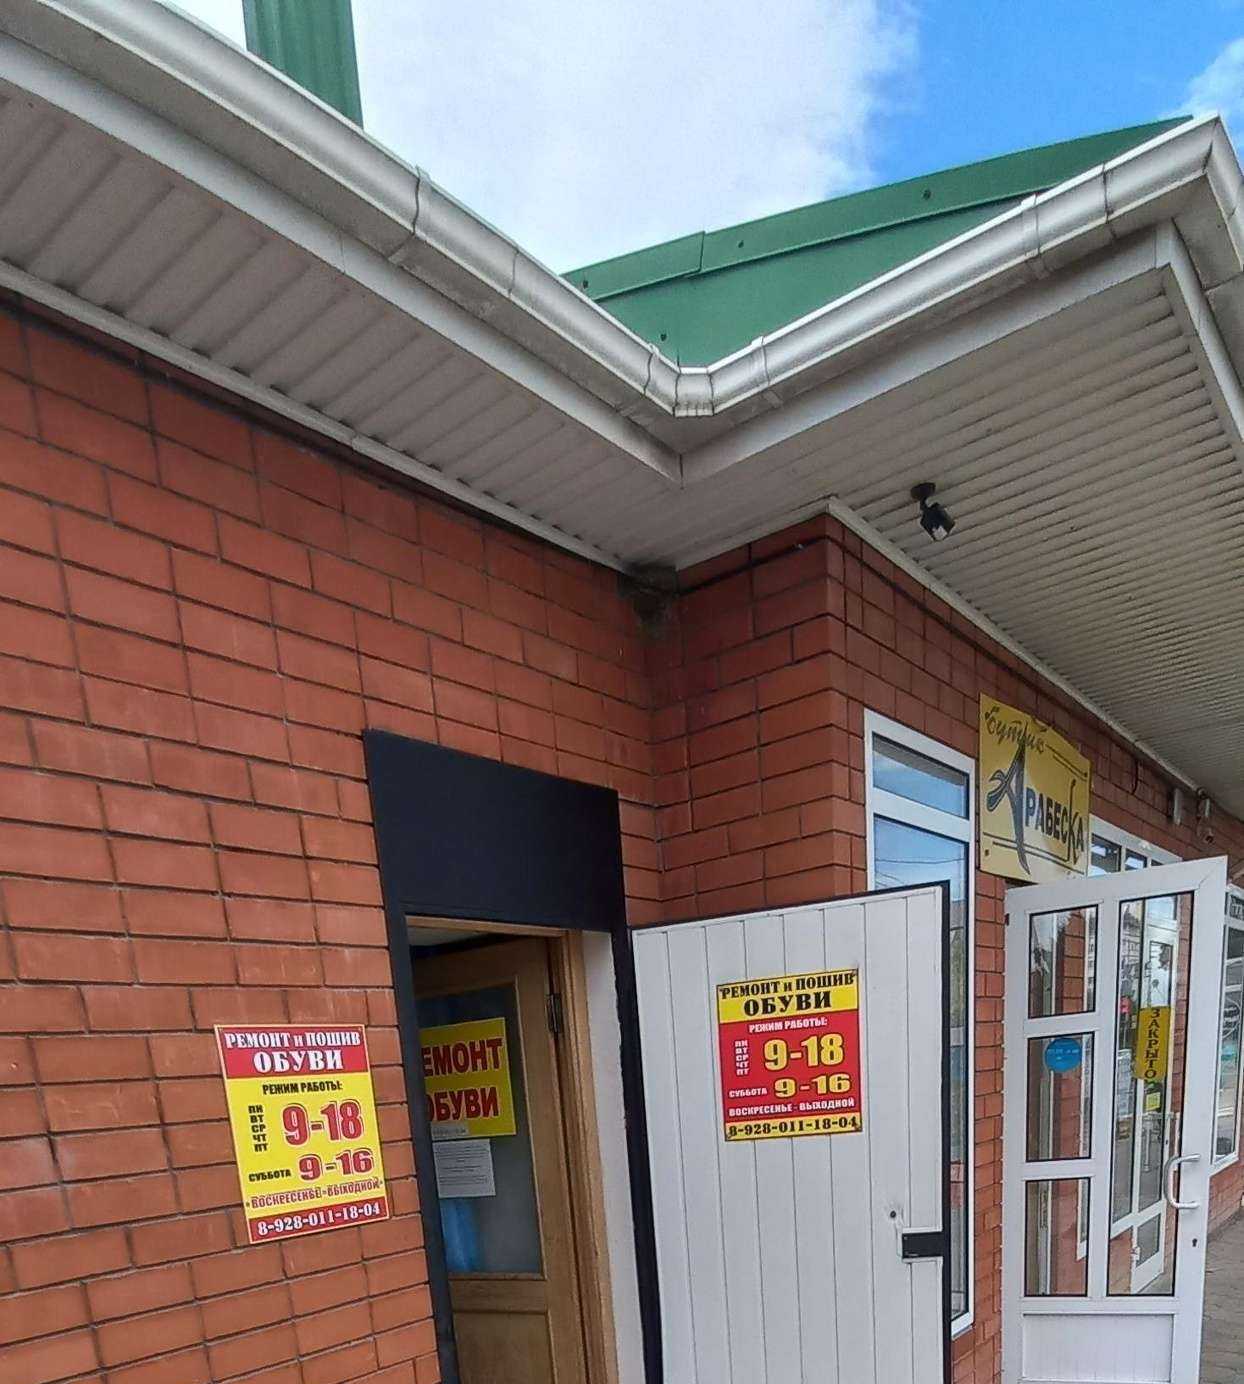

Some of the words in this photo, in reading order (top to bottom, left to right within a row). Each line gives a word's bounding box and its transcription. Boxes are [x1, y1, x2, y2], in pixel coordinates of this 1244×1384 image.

[722, 981, 780, 999] РЕМОНТ
[784, 982, 793, 993] и
[796, 973, 855, 990] ПОШИВ
[744, 991, 831, 1016] ОБУВИ
[749, 1021, 783, 1033] РЕЖИМ
[785, 1017, 828, 1030] РАБОТЫ:
[225, 1032, 290, 1048] РЕМОНТ
[305, 1031, 361, 1046] ПОШИВ
[1144, 1008, 1160, 1078] ЗАКРЫТО
[253, 1049, 344, 1073] ОБУВИ
[422, 1038, 502, 1076] ЕМОНТ
[763, 1033, 843, 1071] 9-18
[262, 1082, 299, 1095] РЕЖИМ
[301, 1080, 343, 1093] РАБОТЫ:
[729, 1087, 767, 1098] СУББОТА
[774, 1073, 851, 1098] 9-16
[248, 1105, 263, 1114] ПН
[729, 1103, 792, 1116] ВОСКРЕСЕНЬЕ
[800, 1098, 855, 1111] ВЫХОДНОЙ
[250, 1115, 264, 1123] ВТ
[251, 1124, 265, 1133] СР
[282, 1099, 364, 1145] 9-18
[729, 1116, 857, 1136] 8-928-011-18-04
[252, 1134, 267, 1143] ЧТ
[254, 1143, 268, 1152] ПТ
[298, 1147, 374, 1181] 9-16
[248, 1169, 292, 1183] СУББОТА
[251, 1187, 321, 1208] ВОСКРЕСЕНЬЕ
[327, 1178, 380, 1196] ВЫХОДНОЙ
[258, 1202, 380, 1236] 8-928-011-18-04
